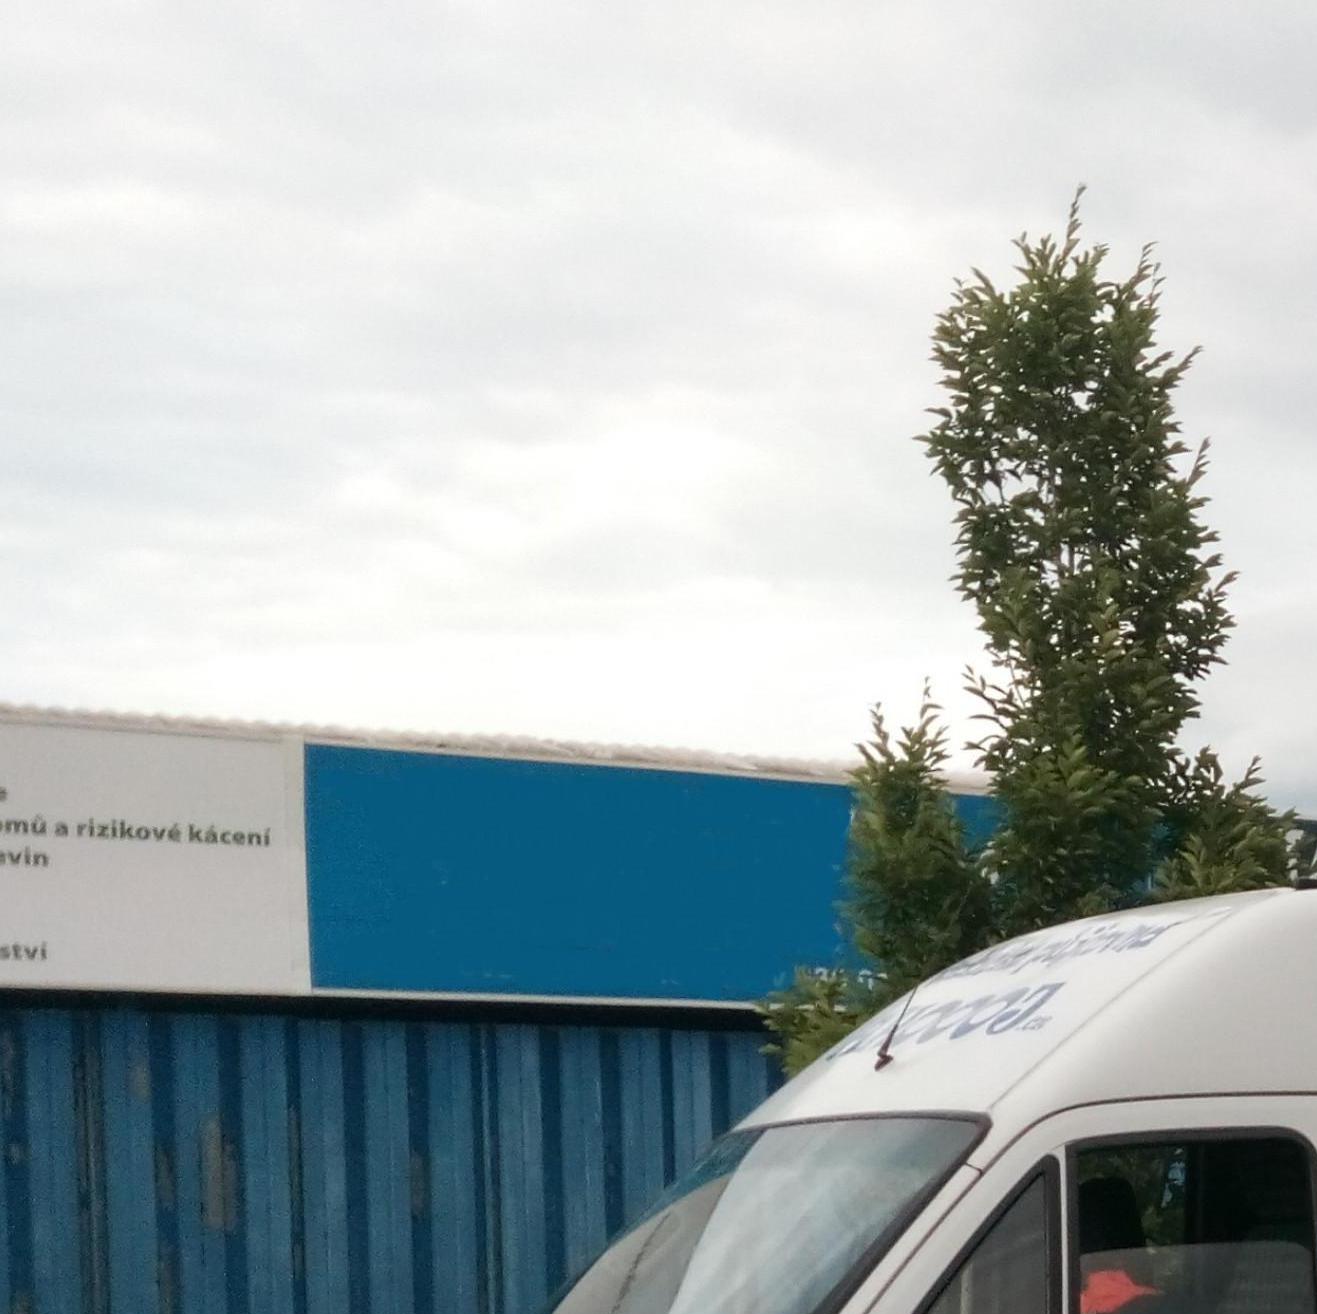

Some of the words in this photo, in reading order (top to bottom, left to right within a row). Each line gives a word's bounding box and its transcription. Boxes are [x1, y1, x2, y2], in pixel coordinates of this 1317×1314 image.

[0, 814, 47, 835] mů
[54, 822, 69, 837] a
[77, 817, 181, 842] rizikové
[188, 823, 271, 846] kácení
